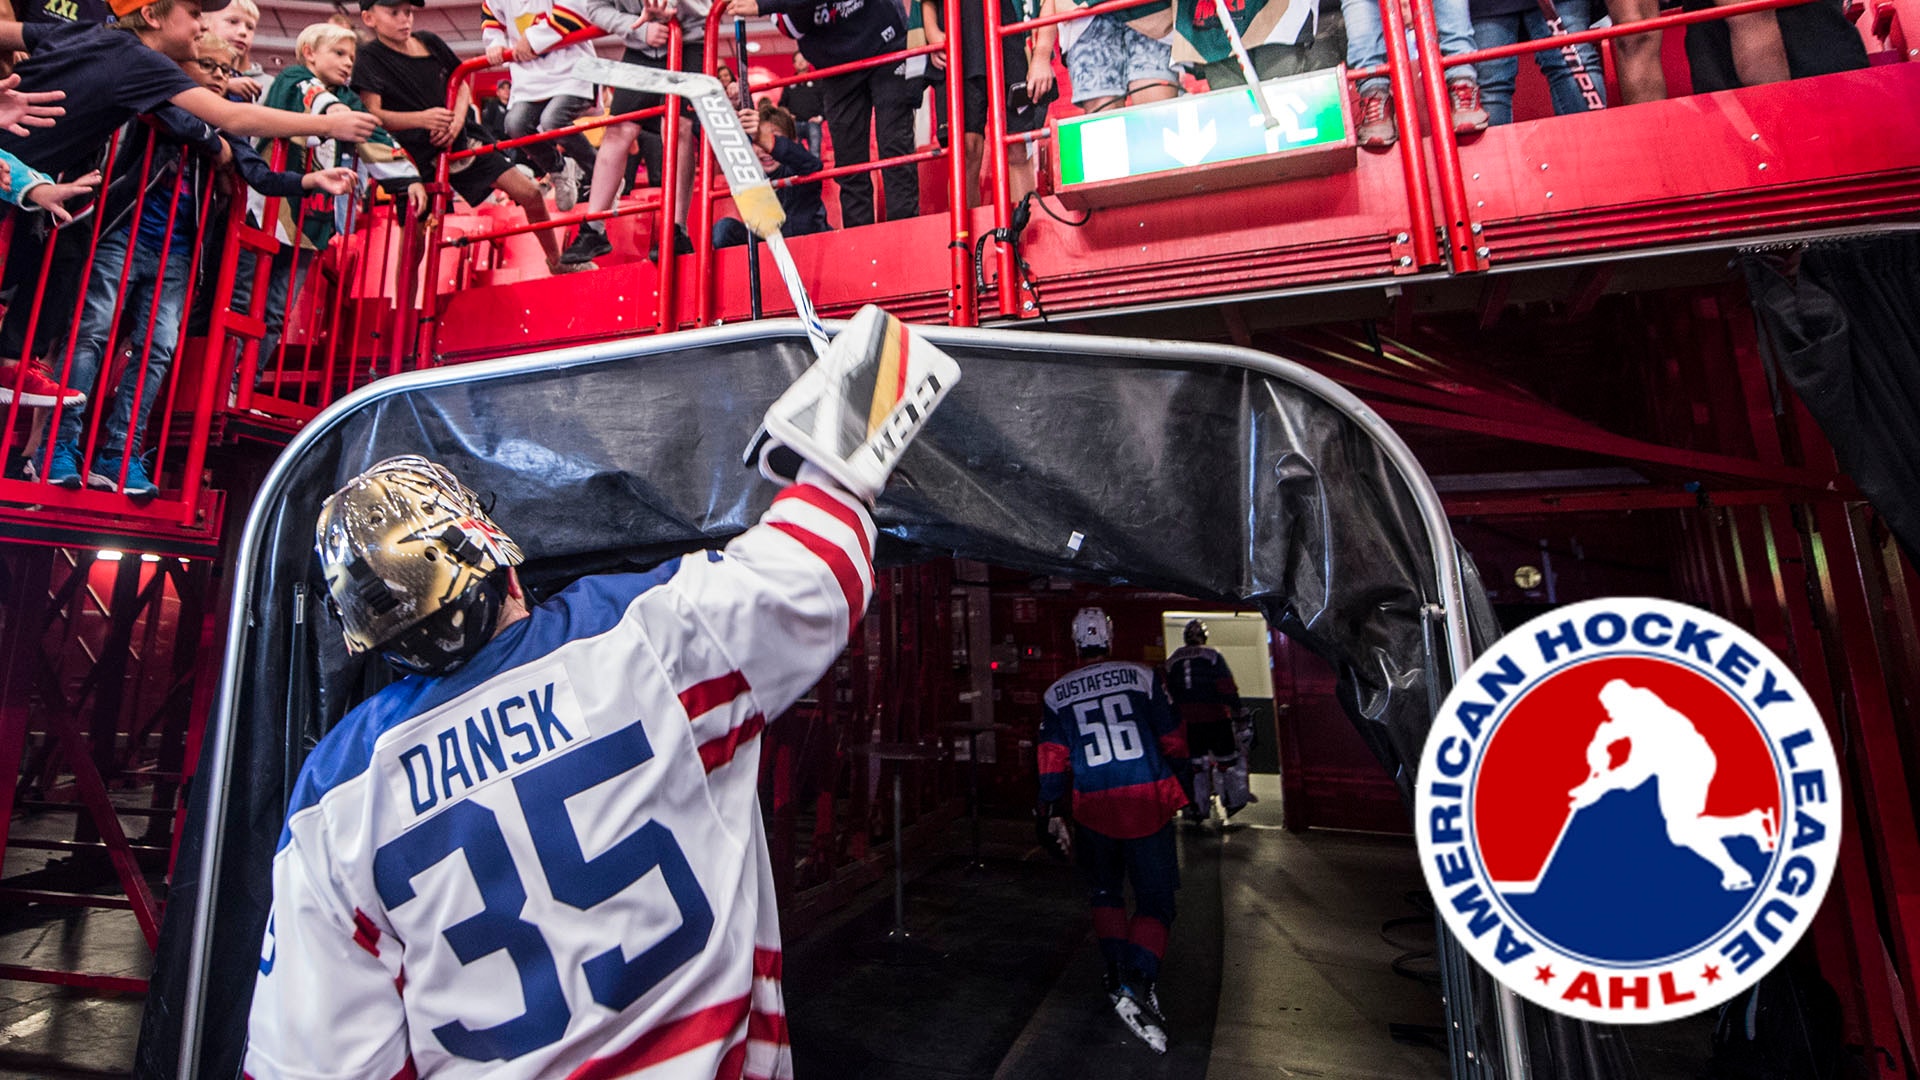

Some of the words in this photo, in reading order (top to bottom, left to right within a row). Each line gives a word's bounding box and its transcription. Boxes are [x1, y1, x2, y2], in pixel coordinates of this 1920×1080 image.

[870, 372, 942, 465] CCM
[1054, 668, 1138, 701] GUSTAFSSON
[1072, 693, 1144, 767] 56
[399, 682, 574, 816] DANSK
[373, 720, 714, 1062] 35
